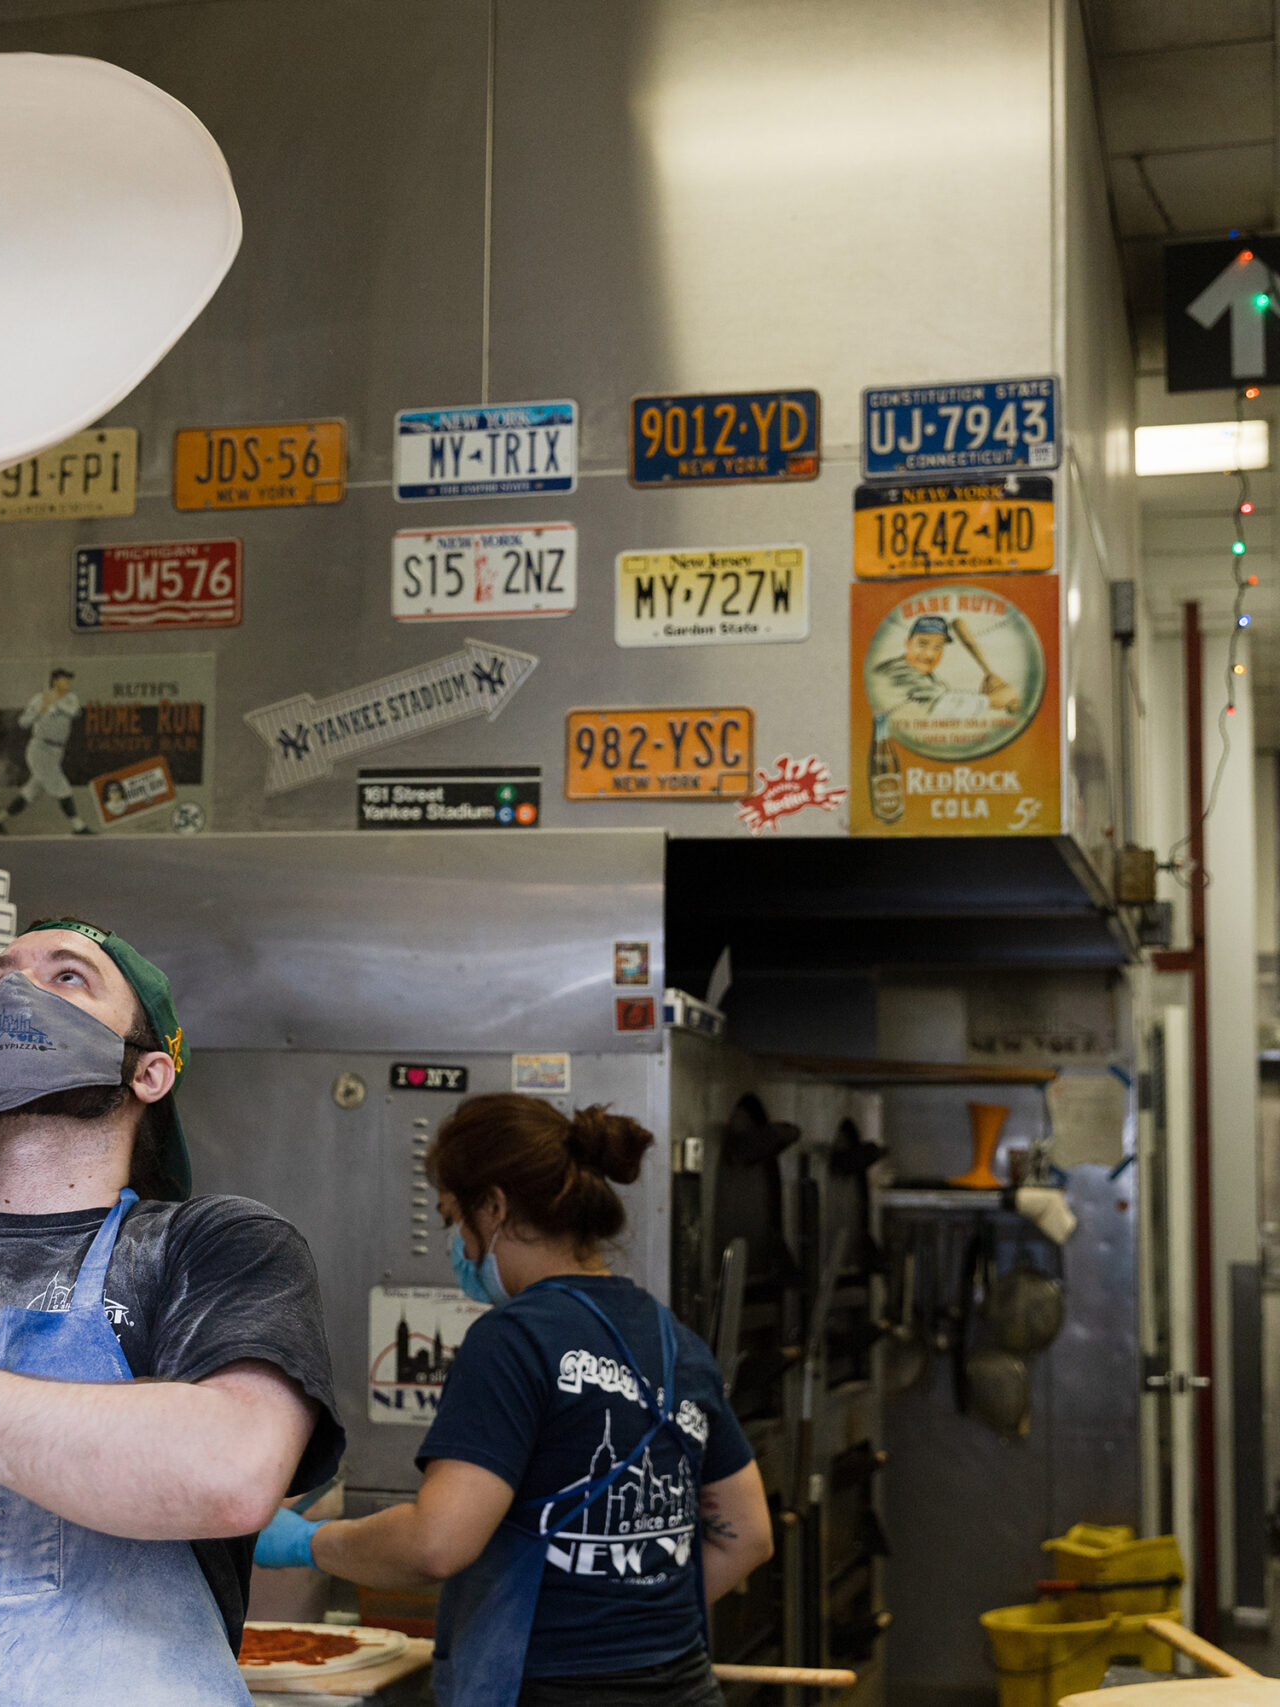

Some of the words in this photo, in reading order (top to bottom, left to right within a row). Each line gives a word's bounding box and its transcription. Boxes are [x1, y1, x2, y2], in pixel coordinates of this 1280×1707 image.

[870, 387, 985, 407] CONSTITUTION
[995, 381, 1051, 399] STATE
[439, 413, 479, 431] NEW
[484, 410, 530, 429] YORK
[678, 459, 716, 476] NEW
[722, 456, 768, 474] YORK
[906, 449, 1014, 468] CONNECTICUT
[216, 486, 251, 502] NEW
[257, 484, 297, 500] YORK
[901, 487, 950, 504] NEW
[953, 484, 1005, 501] YORK
[436, 537, 472, 550] NEW
[479, 535, 523, 549] YORK
[670, 554, 705, 569] New
[708, 552, 753, 569] Jersey
[87, 557, 233, 602] LJW576
[402, 552, 464, 598] S15
[503, 549, 565, 594] 2NZ
[79, 602, 97, 625] 76
[663, 623, 716, 637] Garden
[719, 622, 758, 634] State
[85, 701, 142, 735] HOME
[157, 699, 201, 735] RUN
[313, 698, 388, 745] YANKEE
[387, 671, 470, 722] STADIUM
[576, 719, 741, 770] 982-YSC
[613, 775, 650, 791] NEW
[657, 774, 700, 790] YORK
[391, 784, 445, 803] Street
[362, 803, 424, 821] Yankee
[425, 802, 496, 821] Stadium
[930, 797, 990, 819] COLA
[424, 1067, 463, 1089] NY
[618, 1519, 631, 1534] a
[633, 1513, 665, 1532] slice
[545, 1540, 648, 1577] NEW
